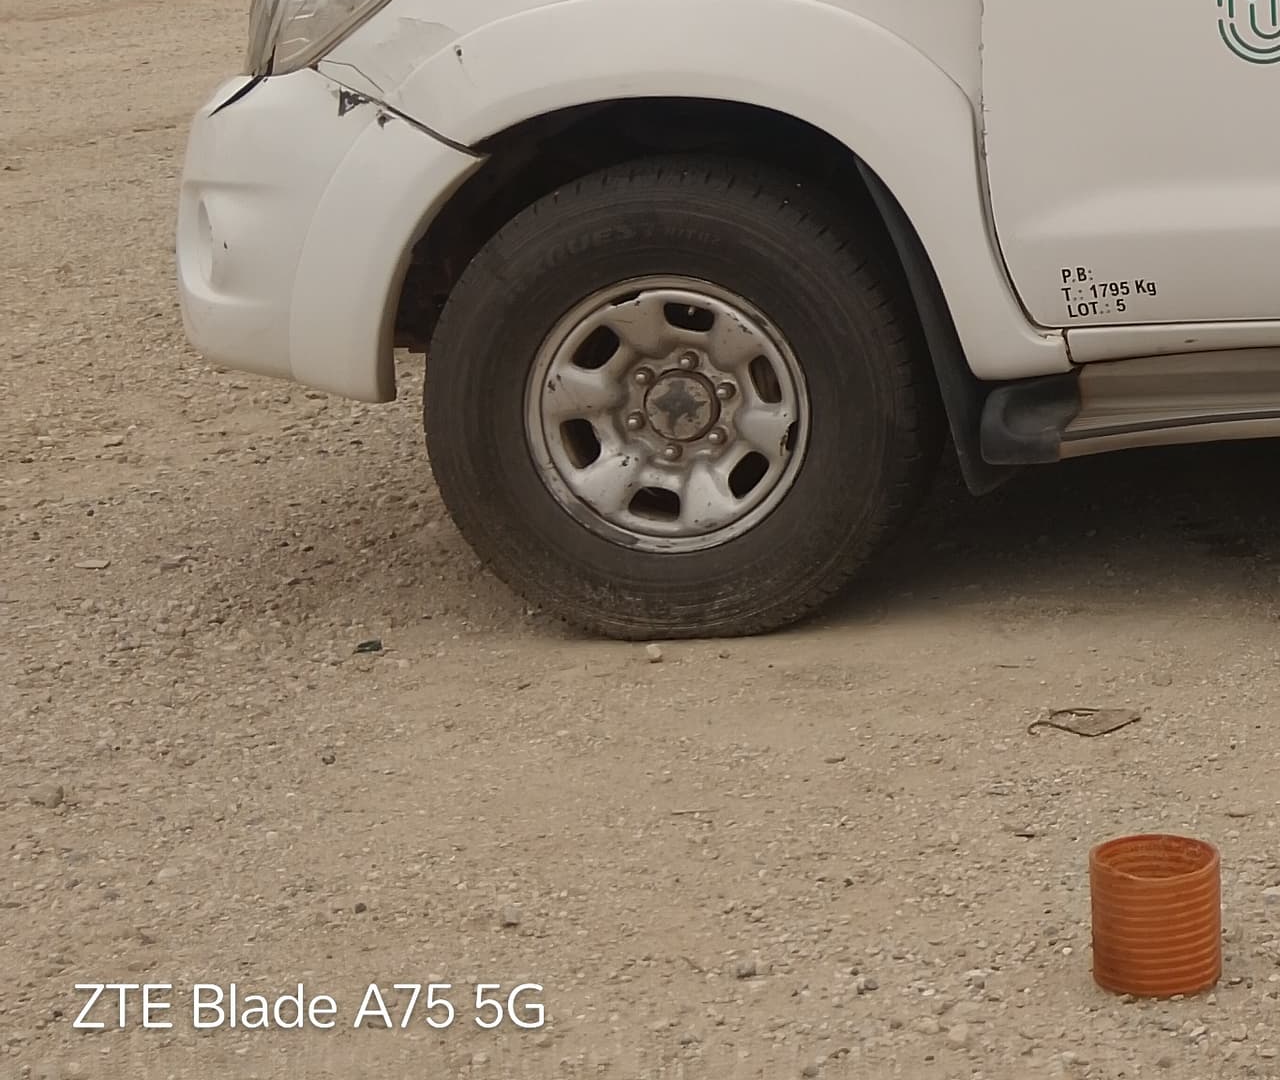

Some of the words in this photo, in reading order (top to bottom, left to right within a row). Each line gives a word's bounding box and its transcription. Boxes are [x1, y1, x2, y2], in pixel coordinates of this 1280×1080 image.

[1089, 281, 1131, 299] 1795
[1134, 278, 1157, 297] Kg
[1115, 298, 1127, 313] 5
